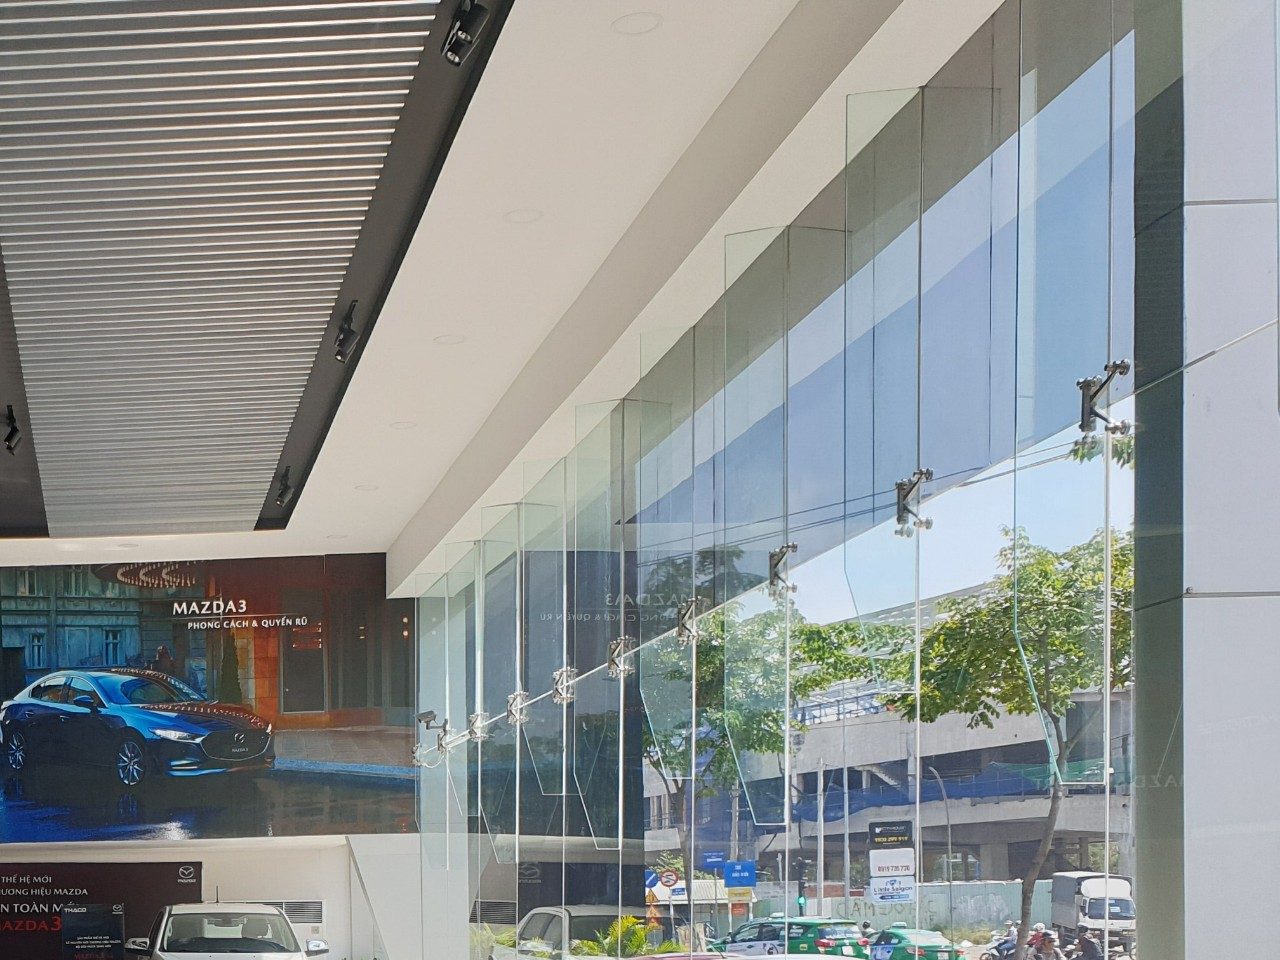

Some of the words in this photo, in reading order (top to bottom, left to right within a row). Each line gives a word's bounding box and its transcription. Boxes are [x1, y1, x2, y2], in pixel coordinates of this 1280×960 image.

[173, 600, 247, 615] MAZDA3
[188, 621, 220, 629] PHONG
[224, 618, 249, 628] CÁCH
[1, 874, 17, 883] THẾ
[20, 875, 31, 884] HỆ
[32, 875, 52, 883] MỚI
[31, 888, 52, 897] HIỆU
[54, 888, 88, 896] MAZDA
[13, 901, 49, 913] TOÀN
